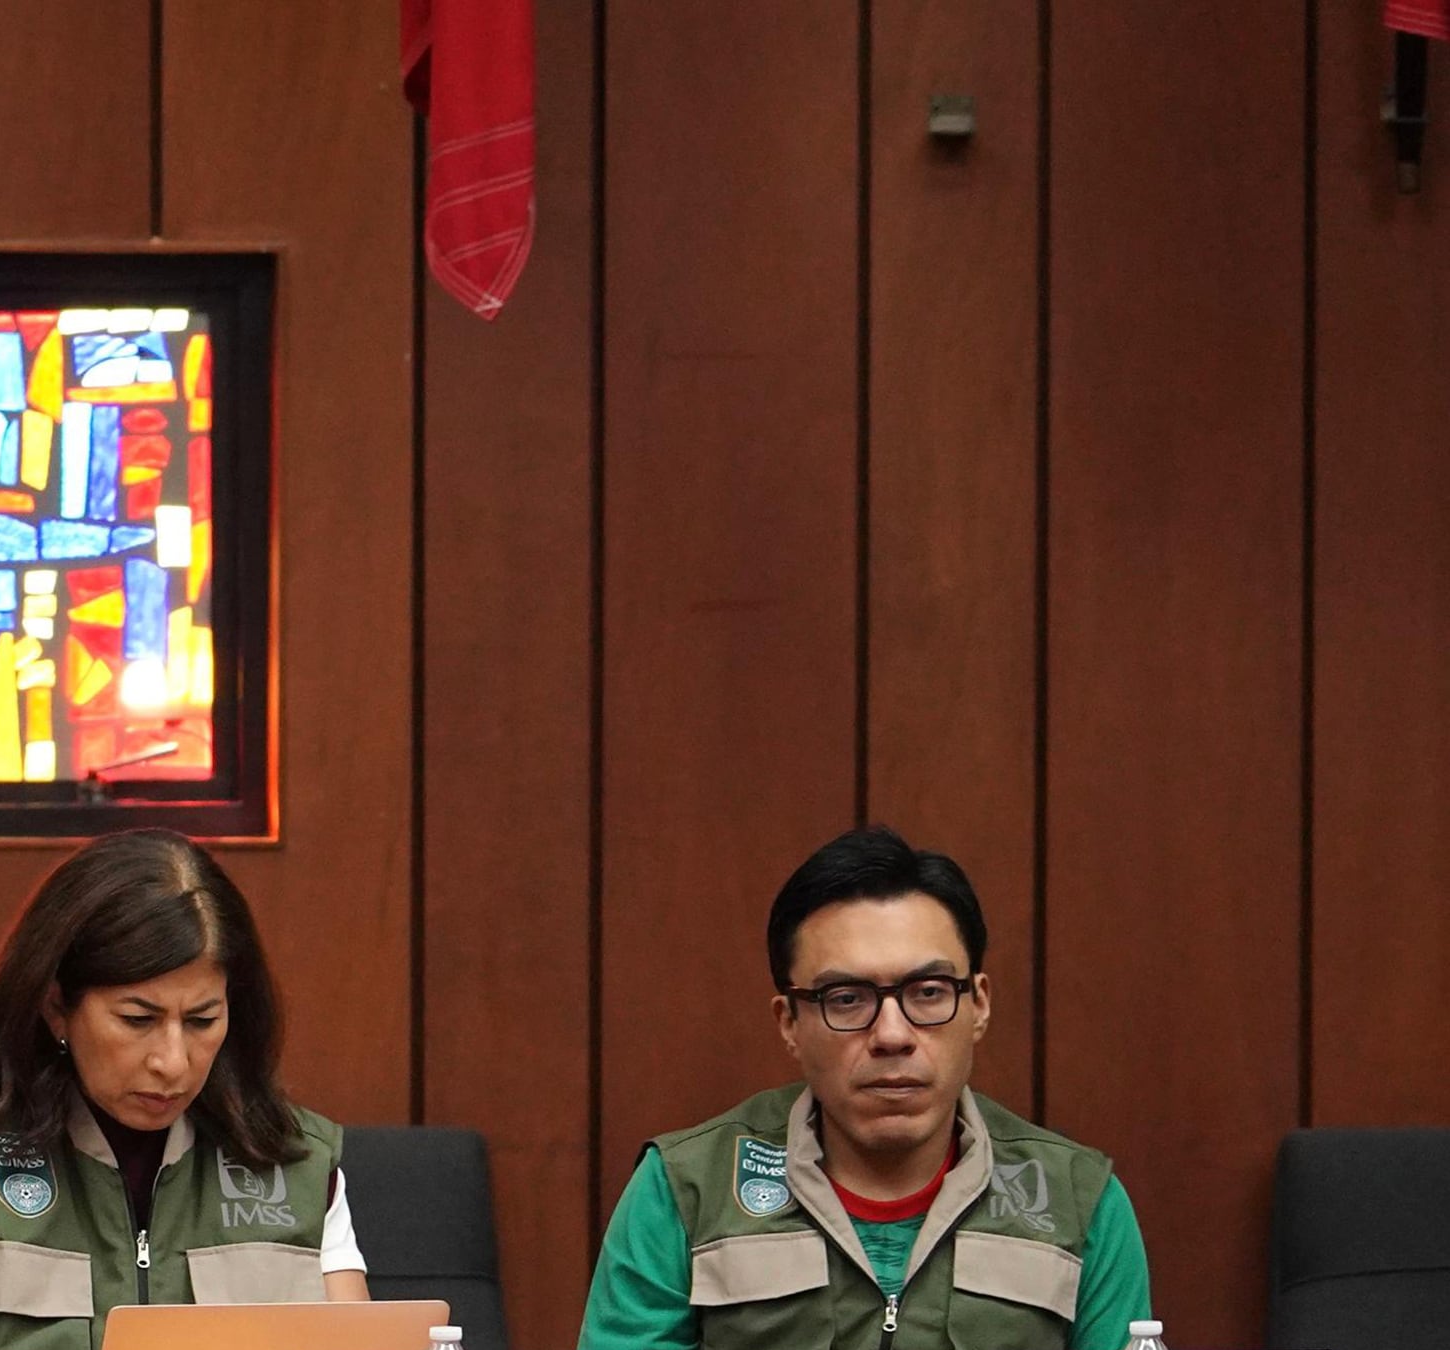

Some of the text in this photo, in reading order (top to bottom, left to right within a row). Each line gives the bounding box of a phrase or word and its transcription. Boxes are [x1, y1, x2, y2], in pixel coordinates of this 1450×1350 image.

[746, 1141, 788, 1157] Comando
[750, 1151, 784, 1165] Central
[756, 1164, 787, 1176] IMSS
[220, 1202, 296, 1227] IMSS
